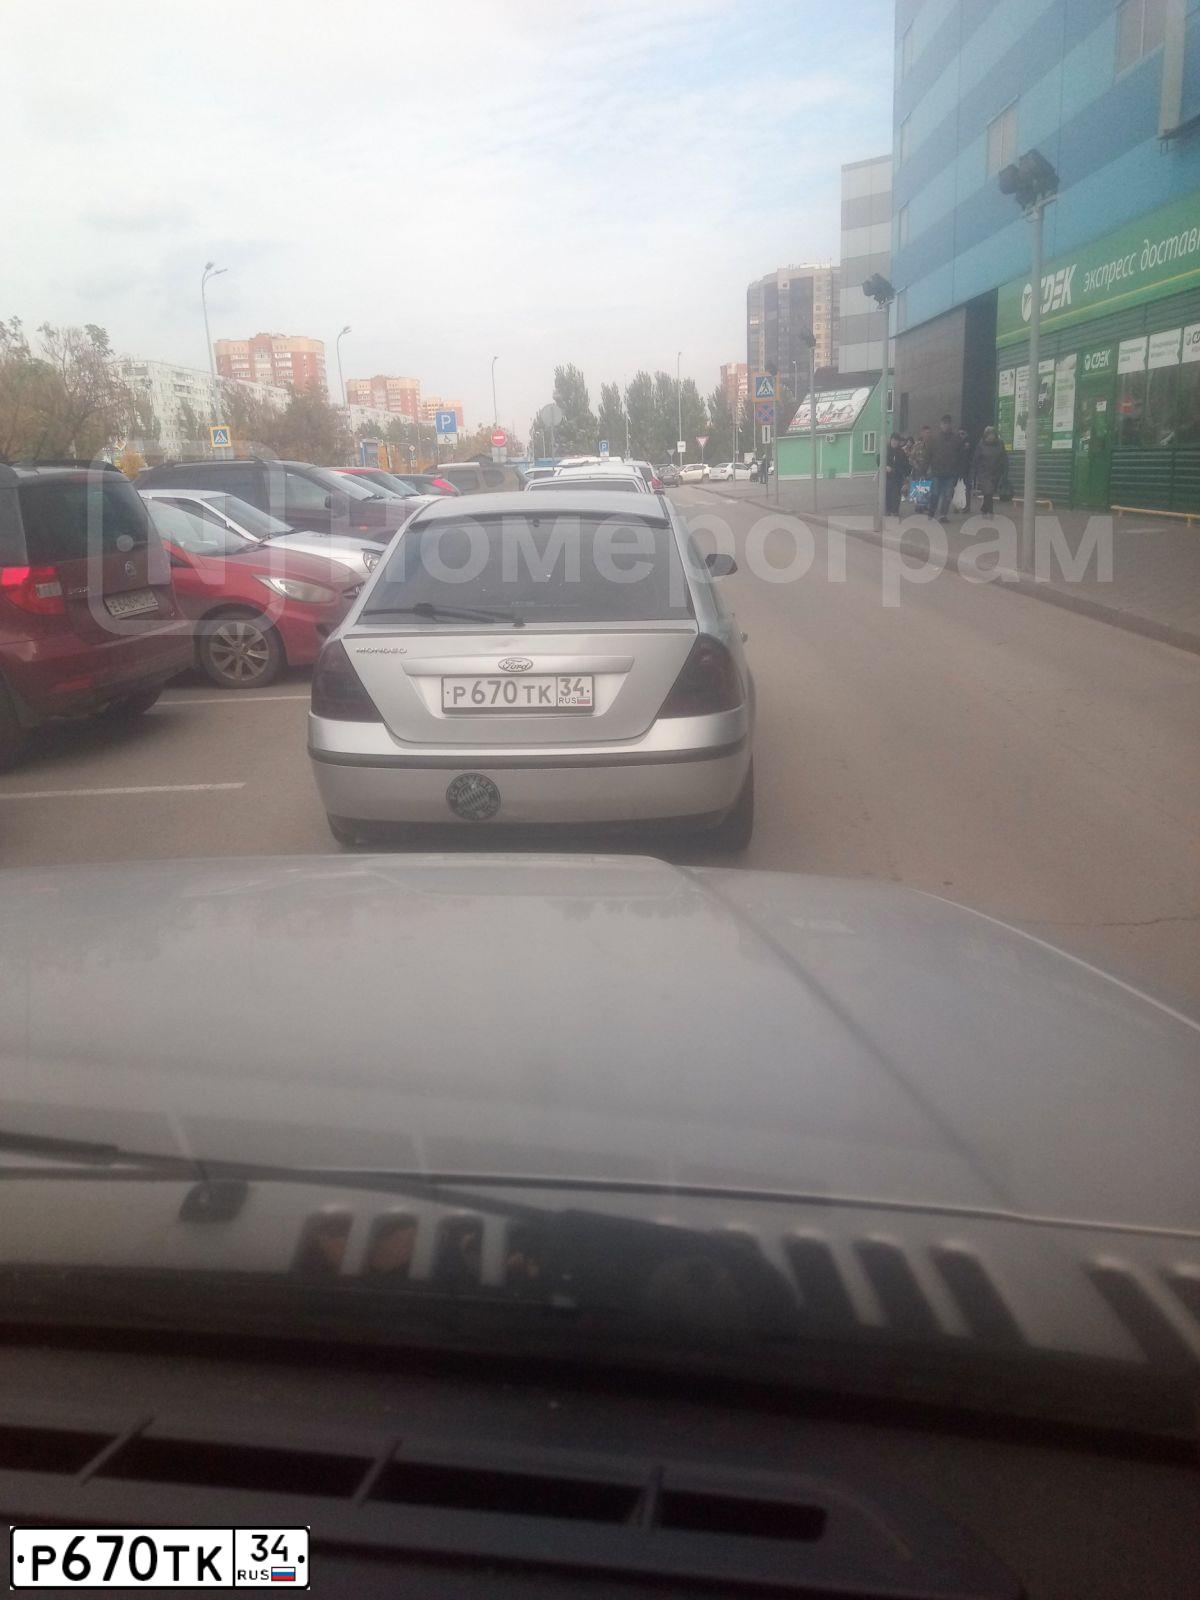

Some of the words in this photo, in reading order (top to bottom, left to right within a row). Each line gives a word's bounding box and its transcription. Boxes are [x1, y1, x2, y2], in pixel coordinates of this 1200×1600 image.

[1035, 264, 1077, 316] DEK
[1083, 252, 1136, 292] экспресс
[1140, 227, 1200, 271] достав
[501, 657, 531, 671] Ford
[559, 678, 584, 696] 34
